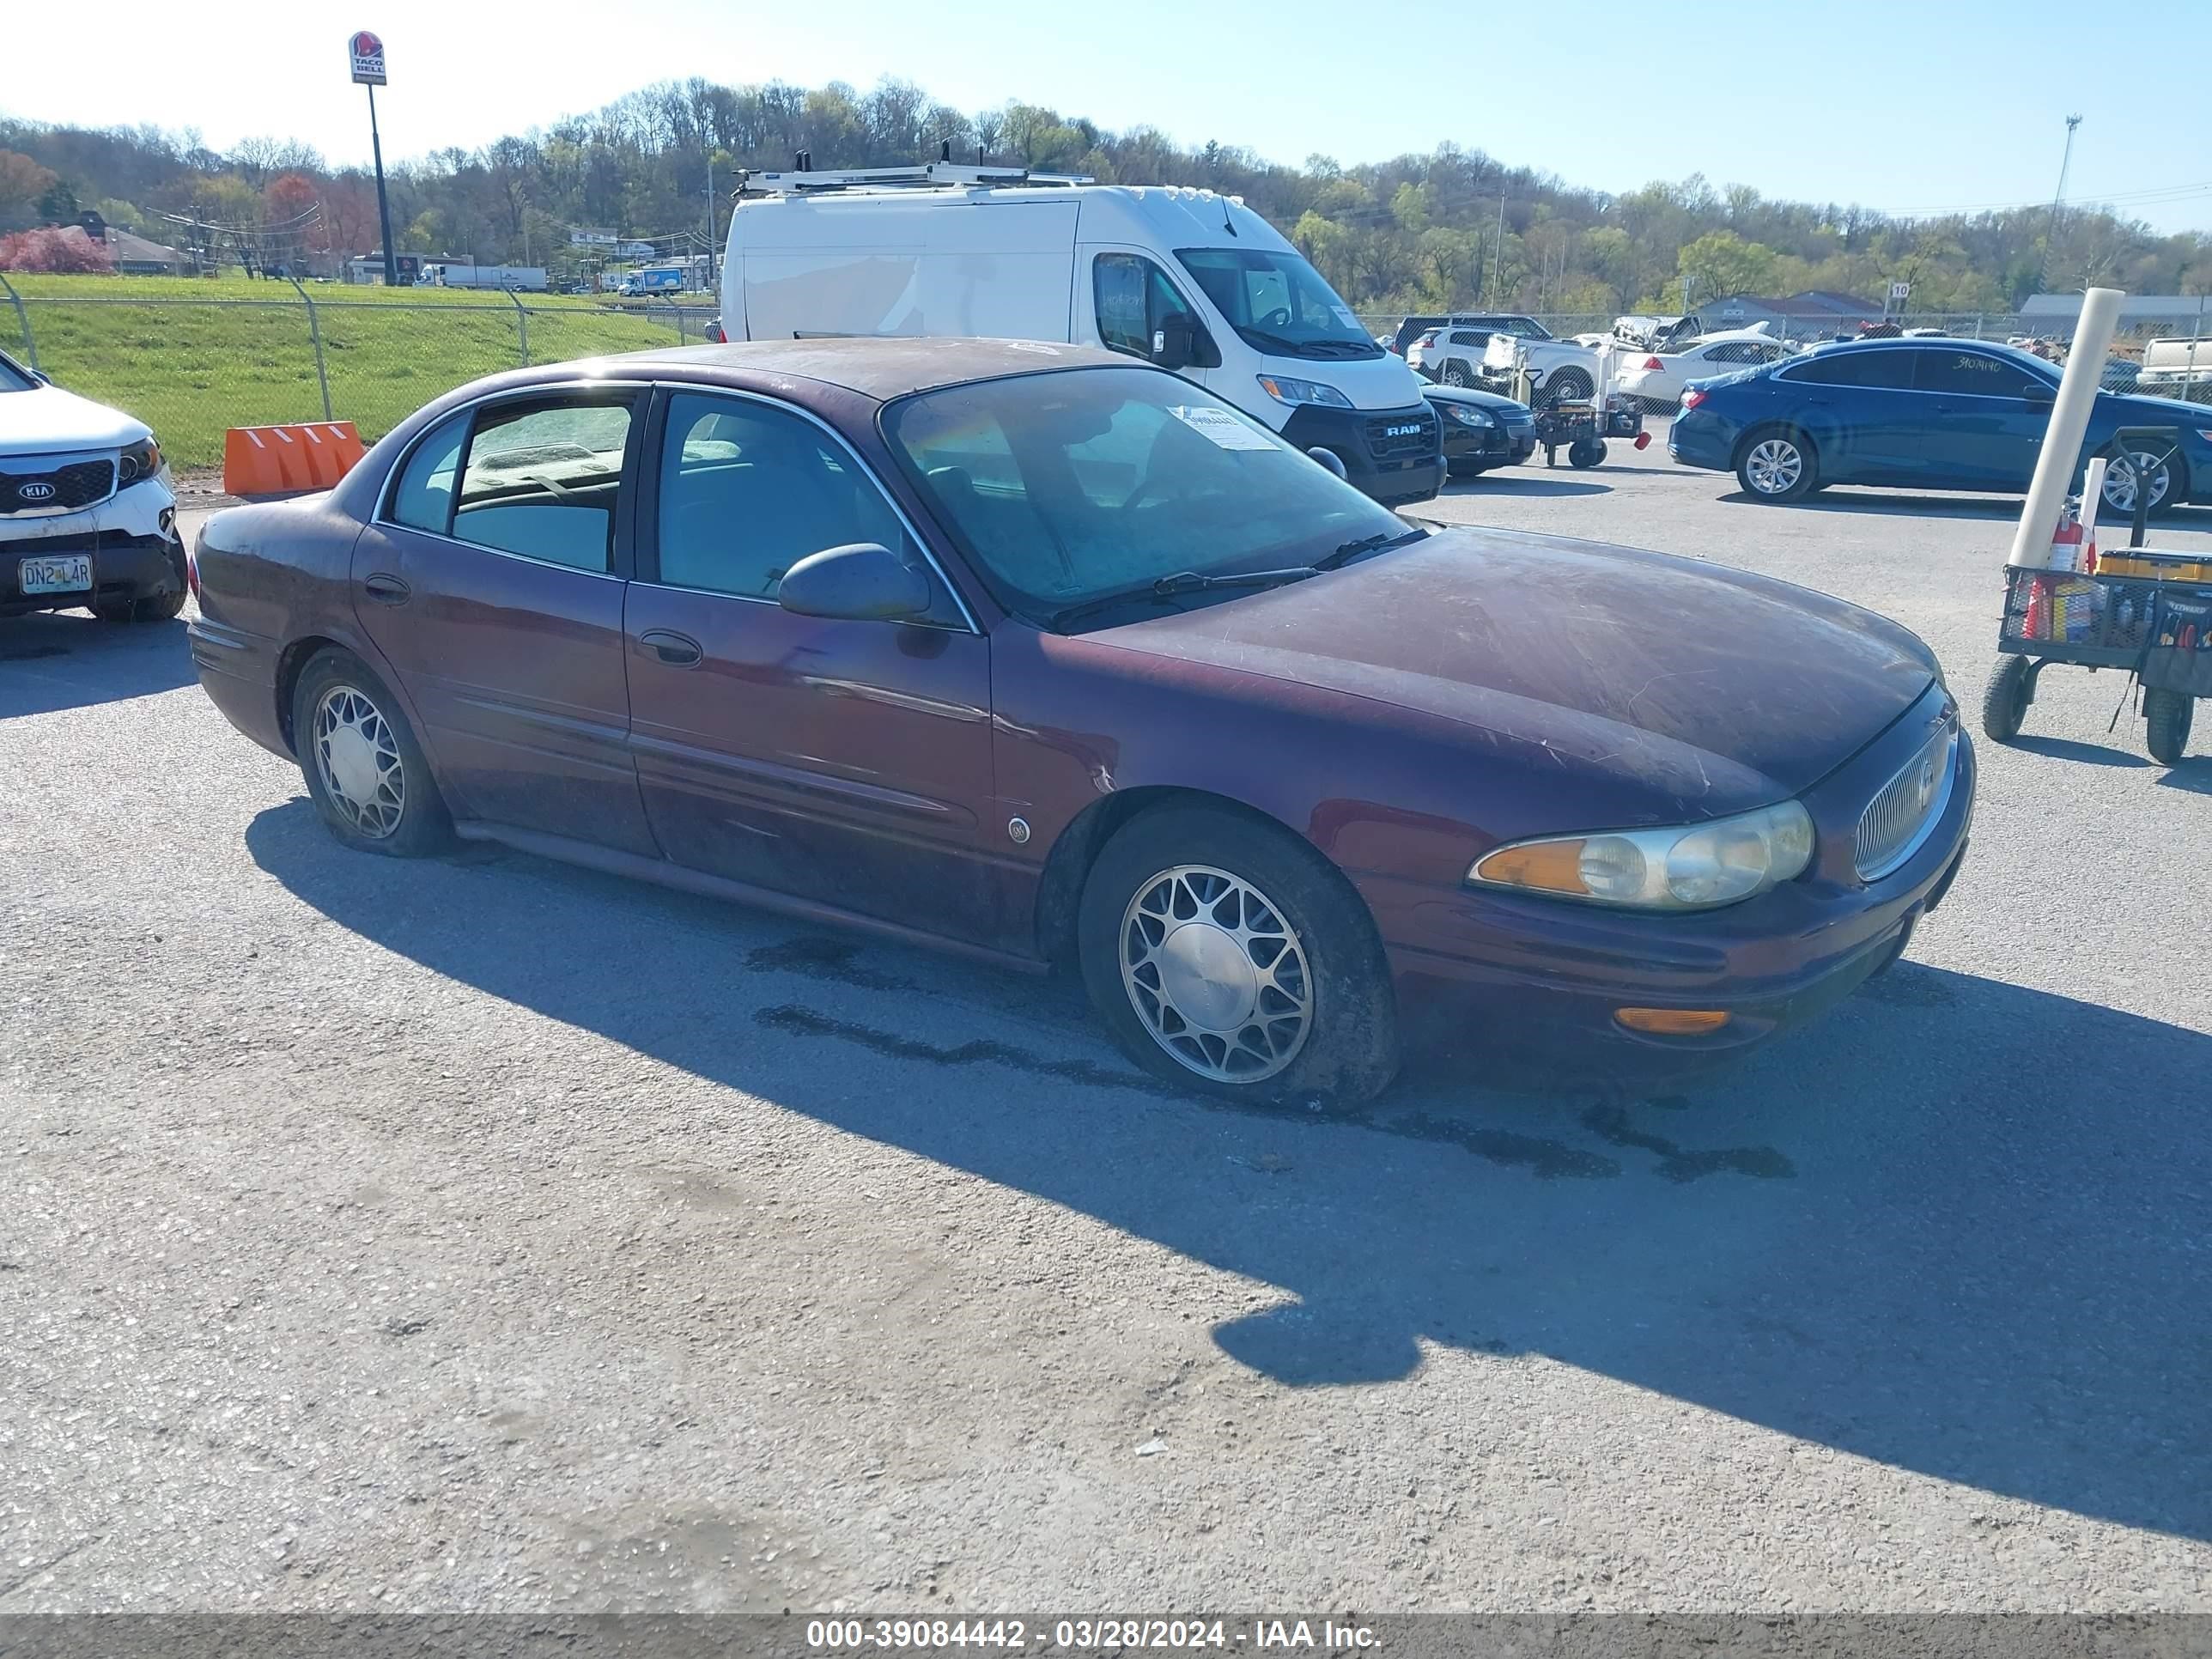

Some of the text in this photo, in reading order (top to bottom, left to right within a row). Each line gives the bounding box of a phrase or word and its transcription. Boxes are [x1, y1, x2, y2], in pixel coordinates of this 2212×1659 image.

[1895, 285, 1908, 295] 10
[1387, 424, 1421, 436] RAM
[25, 486, 50, 496] KIA
[25, 564, 89, 585] DN2 L4R
